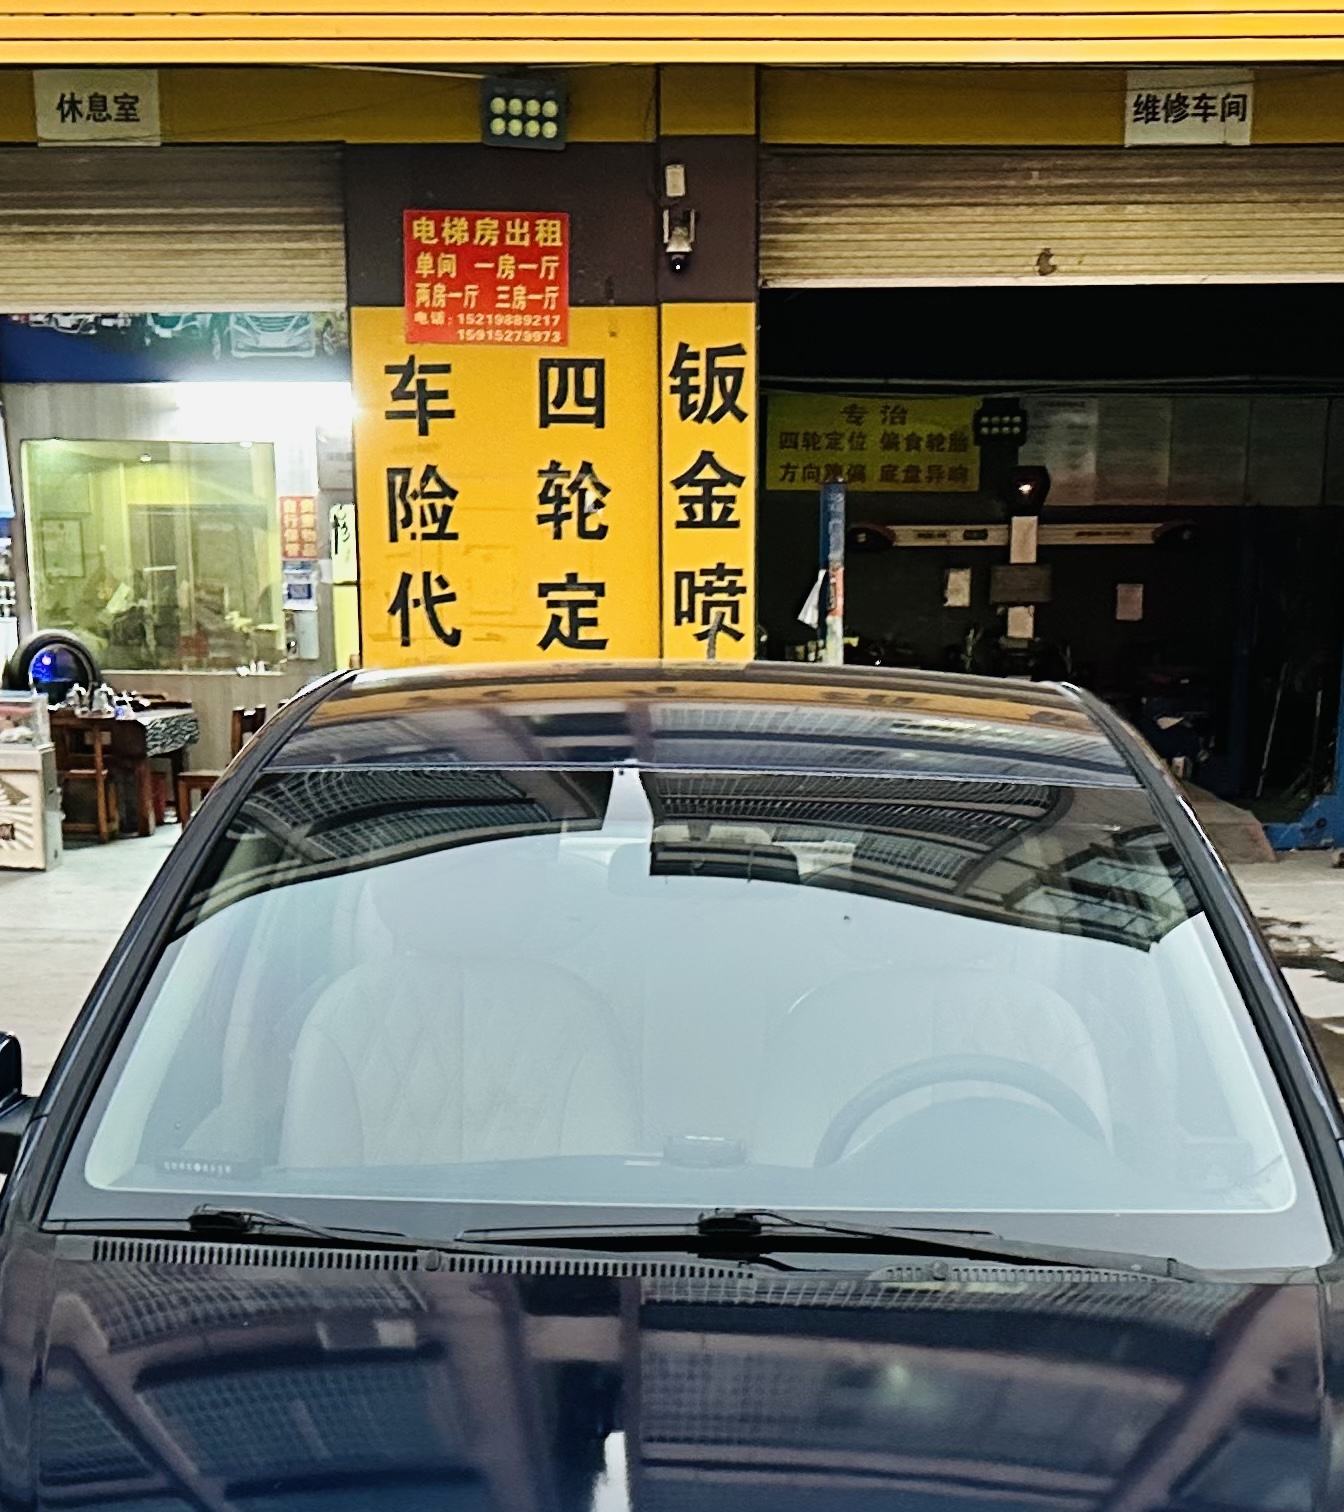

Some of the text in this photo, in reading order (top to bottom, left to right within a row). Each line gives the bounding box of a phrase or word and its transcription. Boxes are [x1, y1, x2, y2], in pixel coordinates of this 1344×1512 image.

[56, 92, 141, 125] 休息室
[1132, 92, 1248, 125] 维修车间
[412, 216, 562, 247] 电梯房出租
[415, 252, 560, 280] 单间 一房一厅
[415, 282, 560, 311] 两房一厅 三房一厅
[779, 431, 867, 451] 四轮定位
[879, 463, 969, 485] 底盘异响
[384, 354, 462, 648] 车险代
[536, 357, 611, 651] 四轮定
[668, 341, 749, 644] 钣金喷
